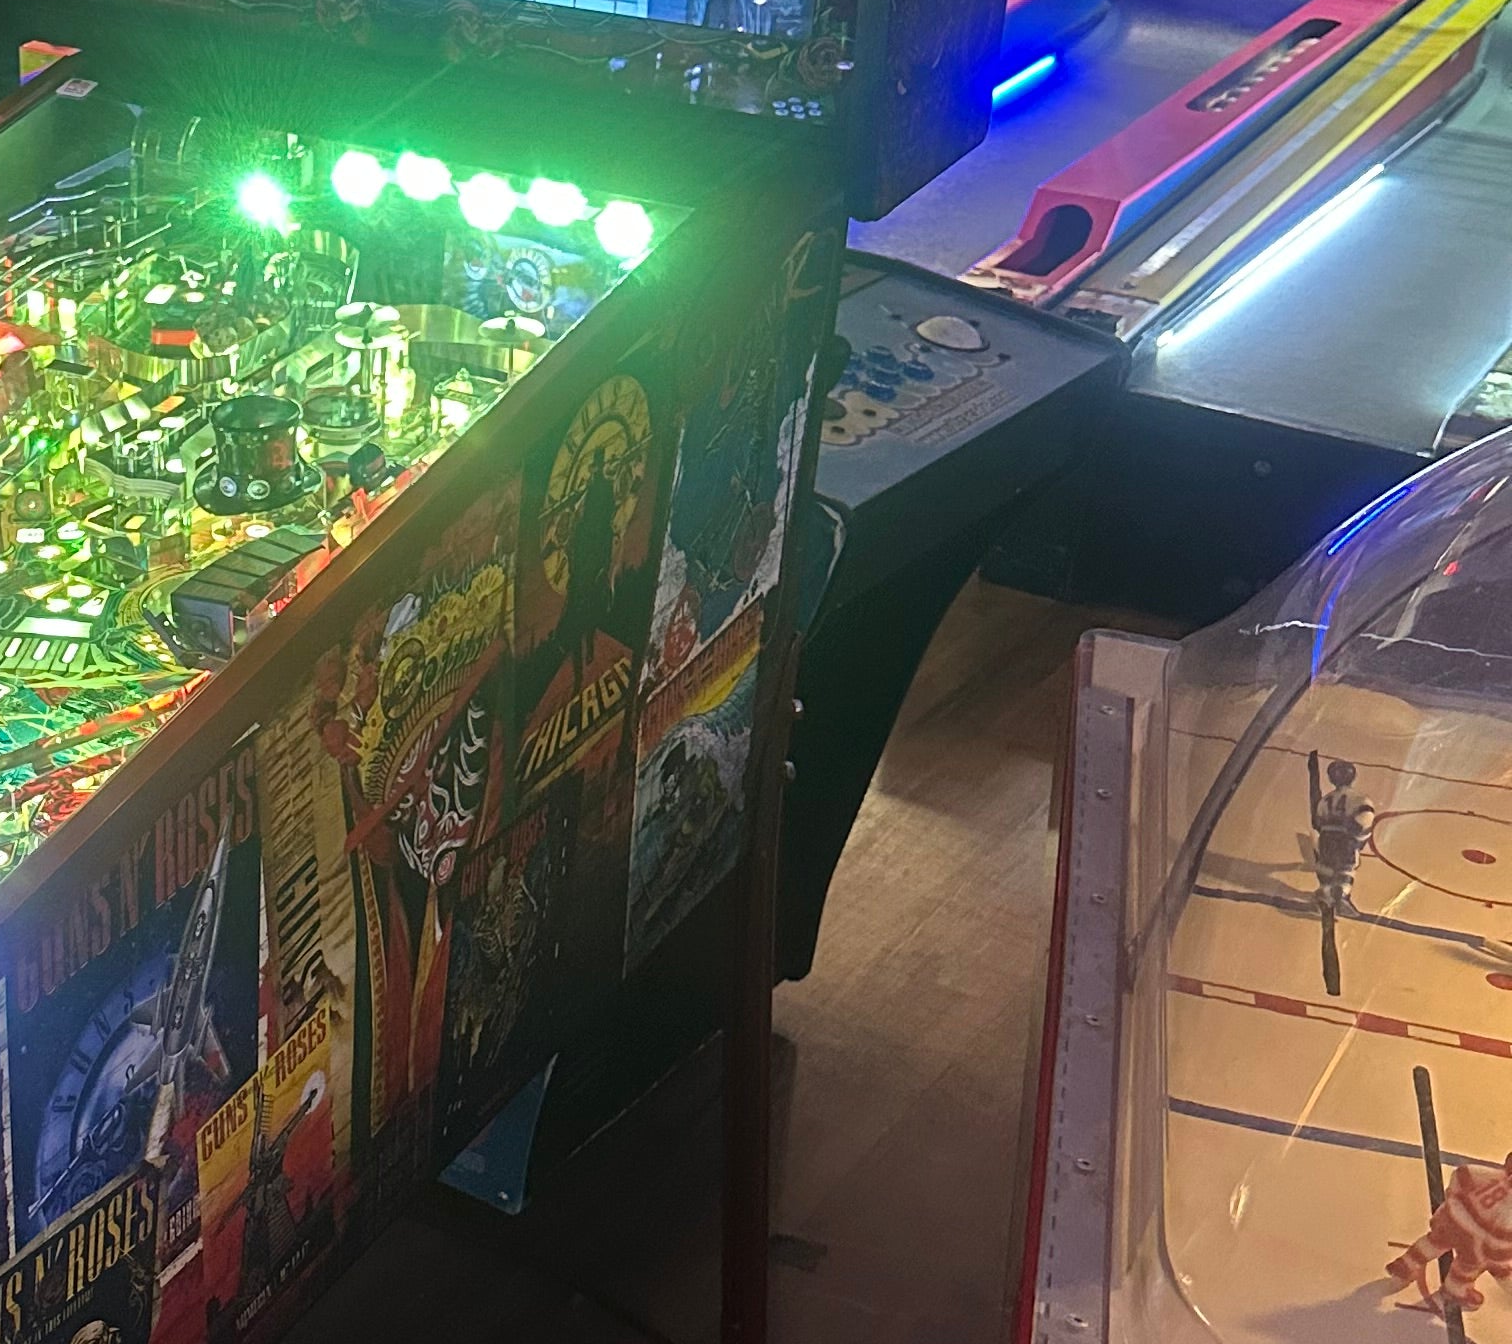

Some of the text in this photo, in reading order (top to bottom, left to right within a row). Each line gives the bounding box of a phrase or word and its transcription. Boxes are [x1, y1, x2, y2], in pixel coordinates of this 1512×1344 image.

[1324, 794, 1347, 814] 14
[16, 868, 112, 1013] GUNS
[154, 746, 255, 911] ROSES
[199, 1090, 249, 1163] GUNS
[274, 1007, 327, 1089] ROSES
[65, 1178, 155, 1302] ROSES
